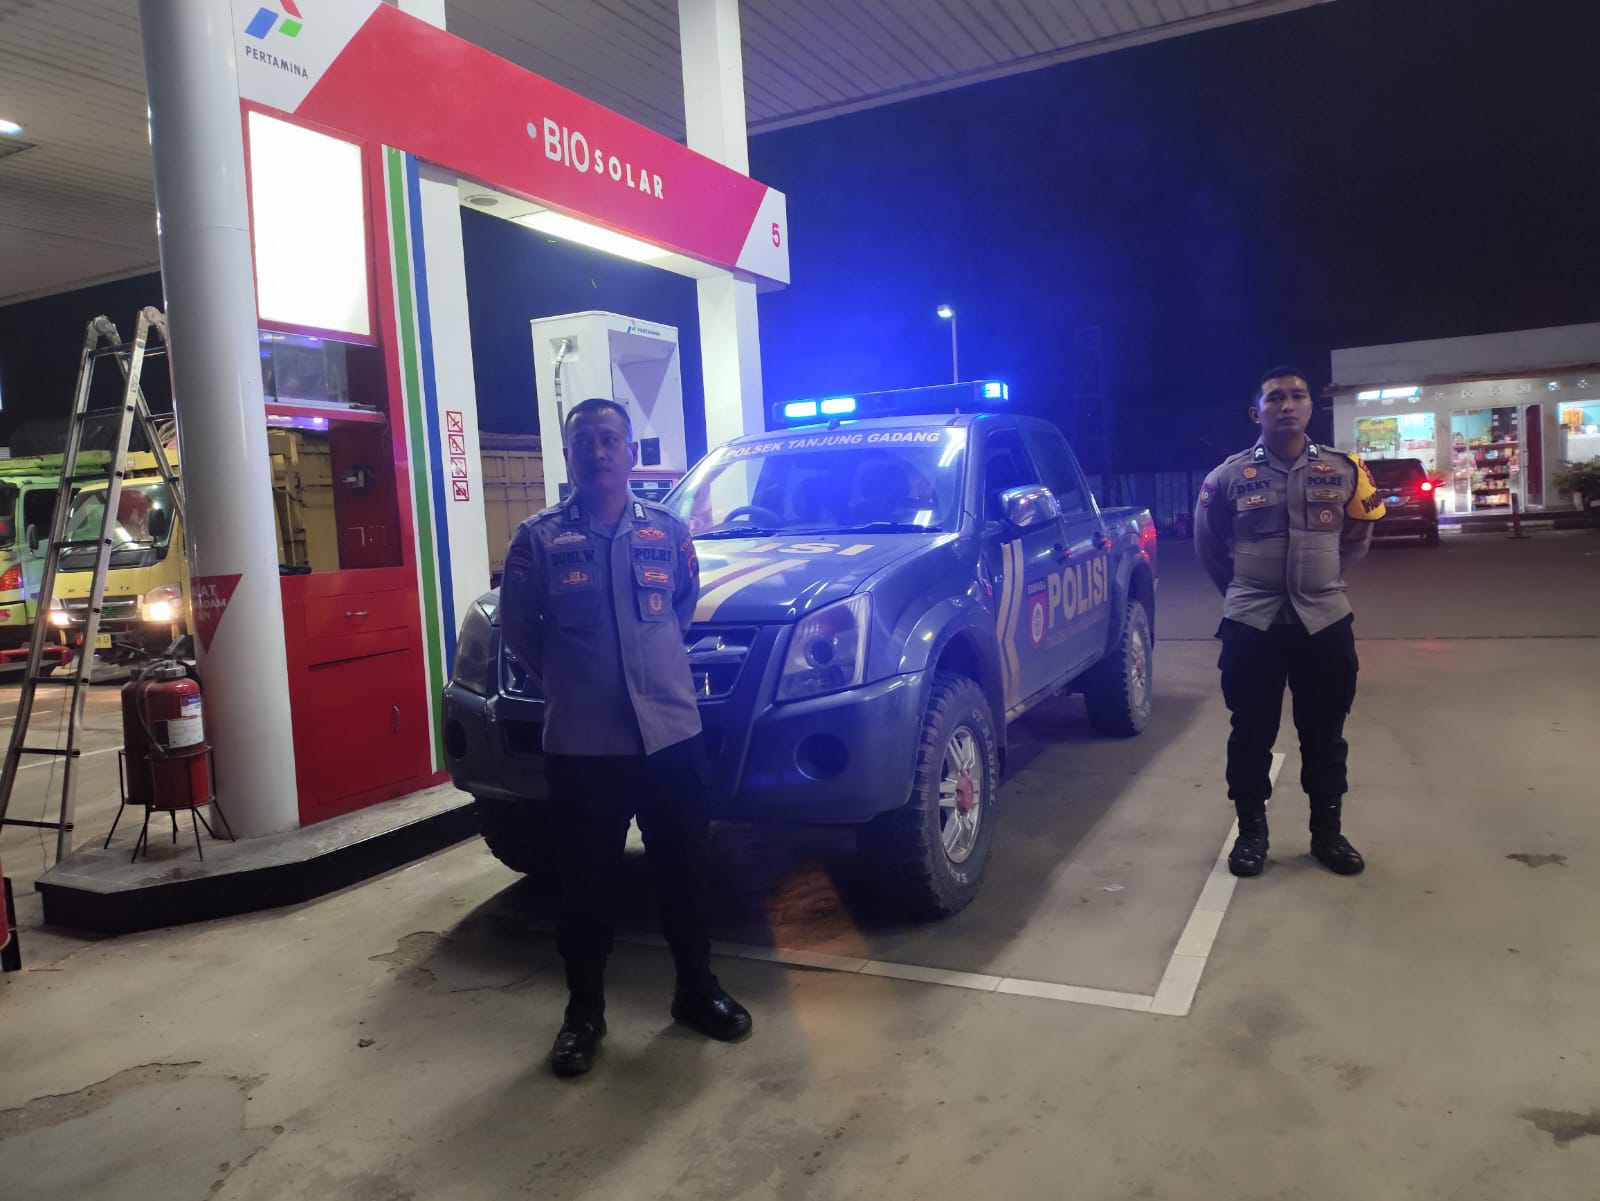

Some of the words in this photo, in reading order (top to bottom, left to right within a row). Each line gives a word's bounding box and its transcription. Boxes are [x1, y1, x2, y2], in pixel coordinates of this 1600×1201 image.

[245, 45, 309, 79] PERTAMINA
[594, 148, 664, 200] SOLAR
[772, 222, 781, 248] 5
[725, 441, 784, 458] POLSEK
[788, 433, 863, 450] TANJUNG
[866, 431, 941, 444] GADANG
[1236, 479, 1272, 495] DEKY
[1307, 475, 1342, 487] POLRI
[633, 547, 671, 562] POLRI
[1047, 555, 1108, 629] POLISI
